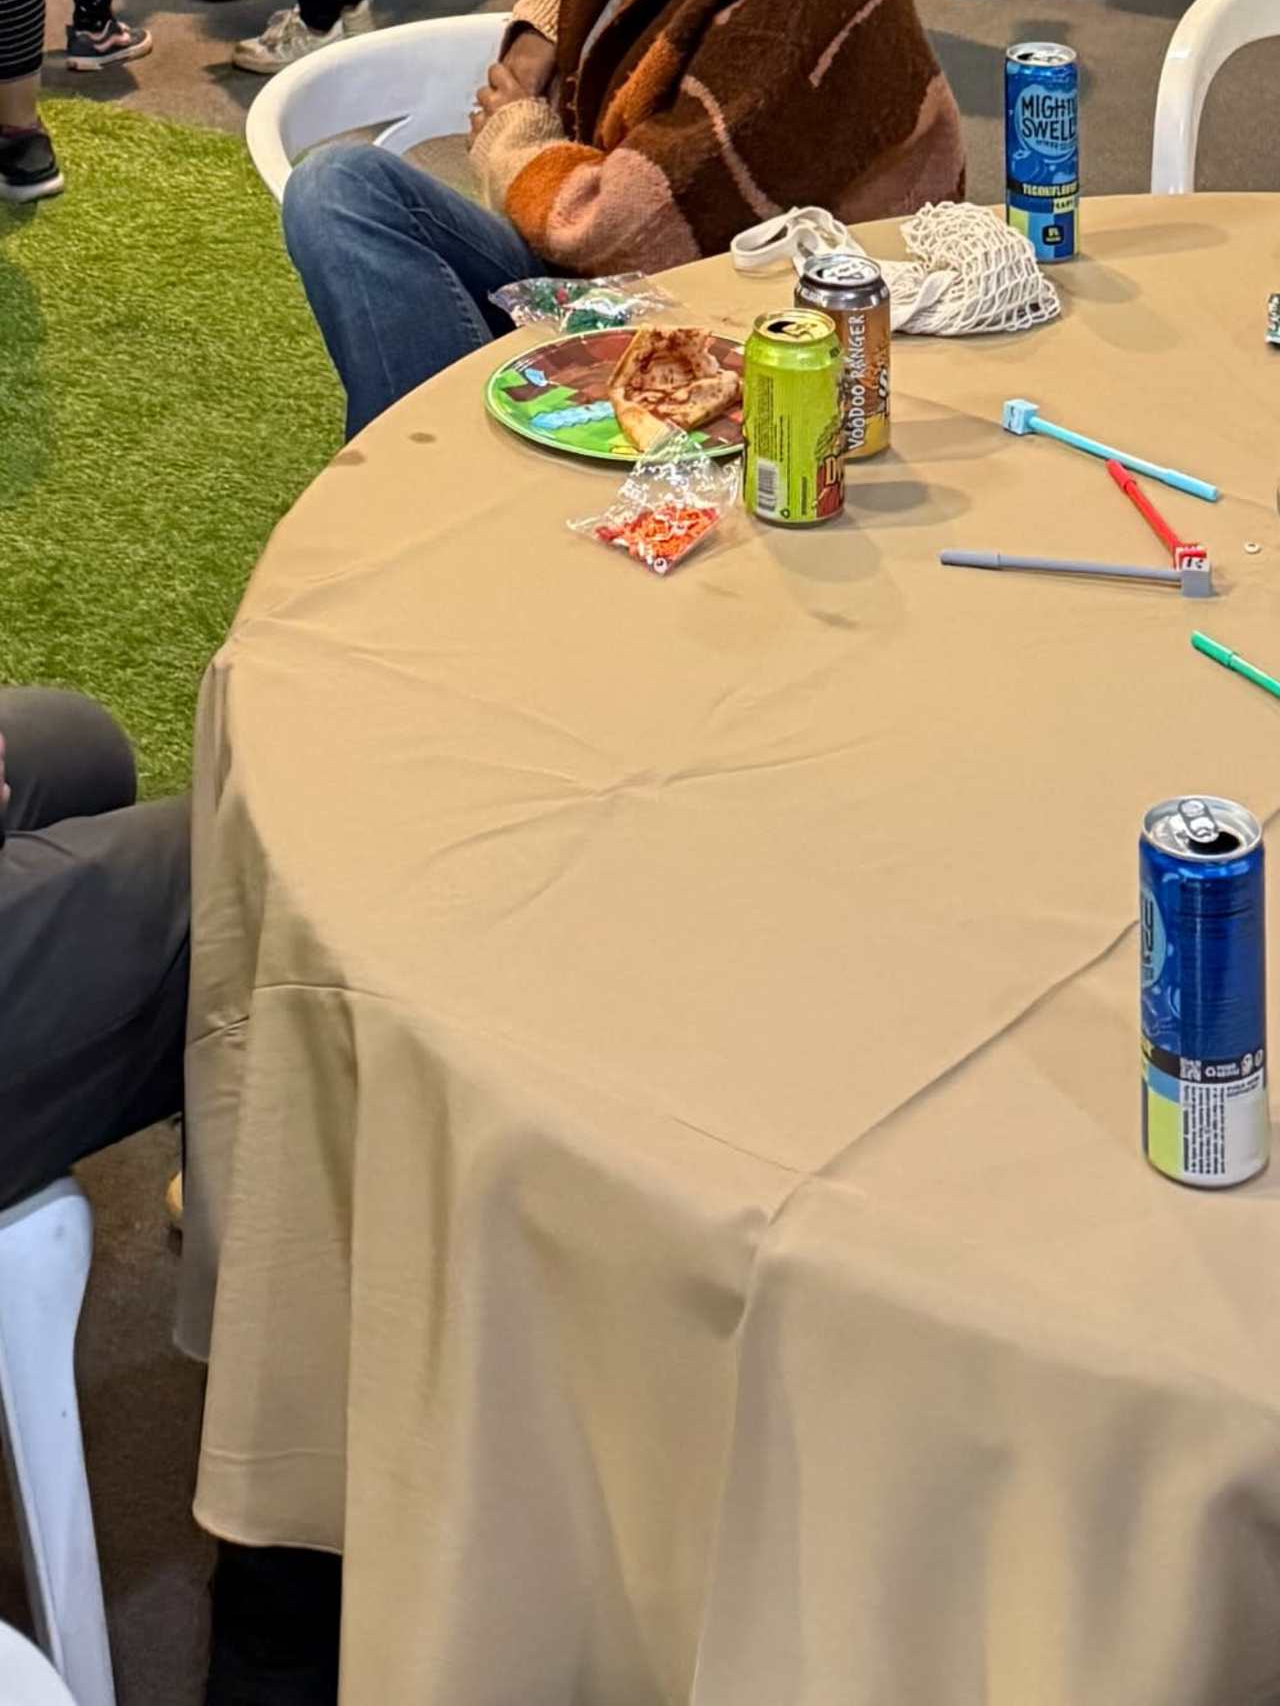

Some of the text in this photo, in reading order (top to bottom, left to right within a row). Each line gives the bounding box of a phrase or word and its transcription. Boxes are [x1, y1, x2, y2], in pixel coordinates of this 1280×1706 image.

[1022, 117, 1076, 141] SWELL
[846, 314, 867, 450] VOODOO RANGER
